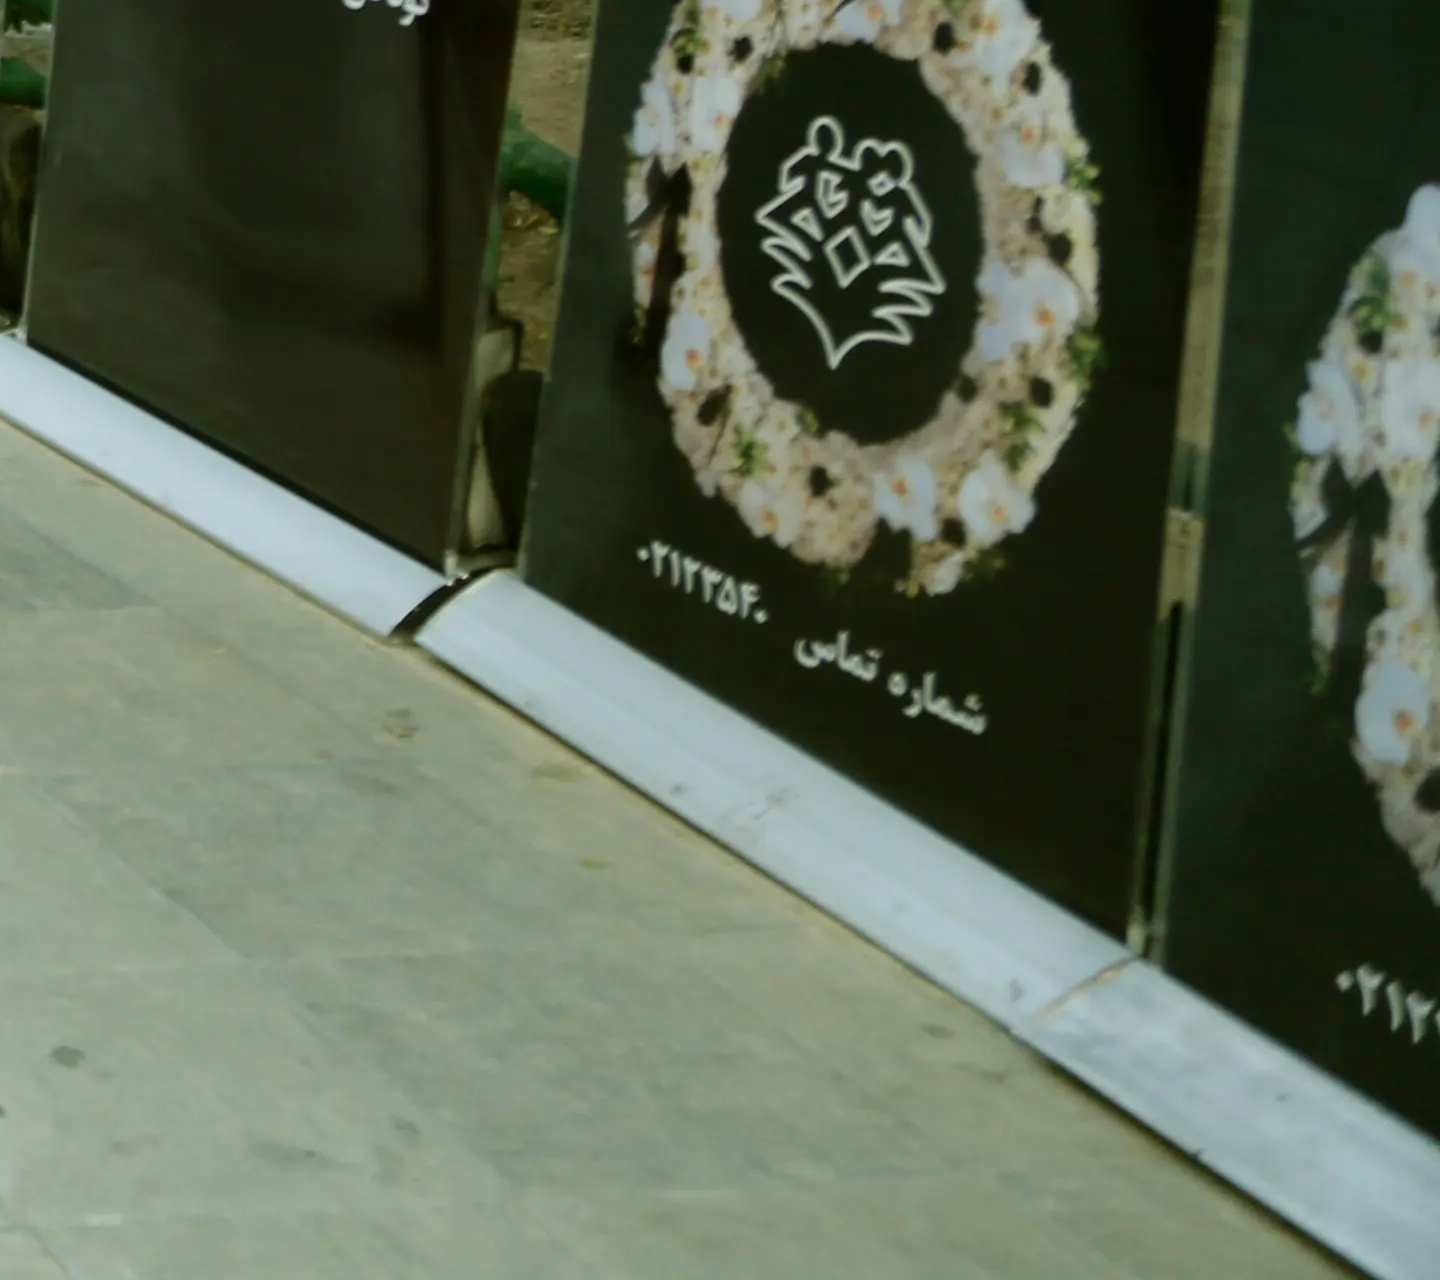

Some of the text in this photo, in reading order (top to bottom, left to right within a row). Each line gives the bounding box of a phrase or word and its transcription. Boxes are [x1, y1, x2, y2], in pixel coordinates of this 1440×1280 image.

[794, 630, 883, 681] تماس
[888, 672, 987, 735] شماره
[1335, 962, 1440, 1045] ۰۲۱۲
